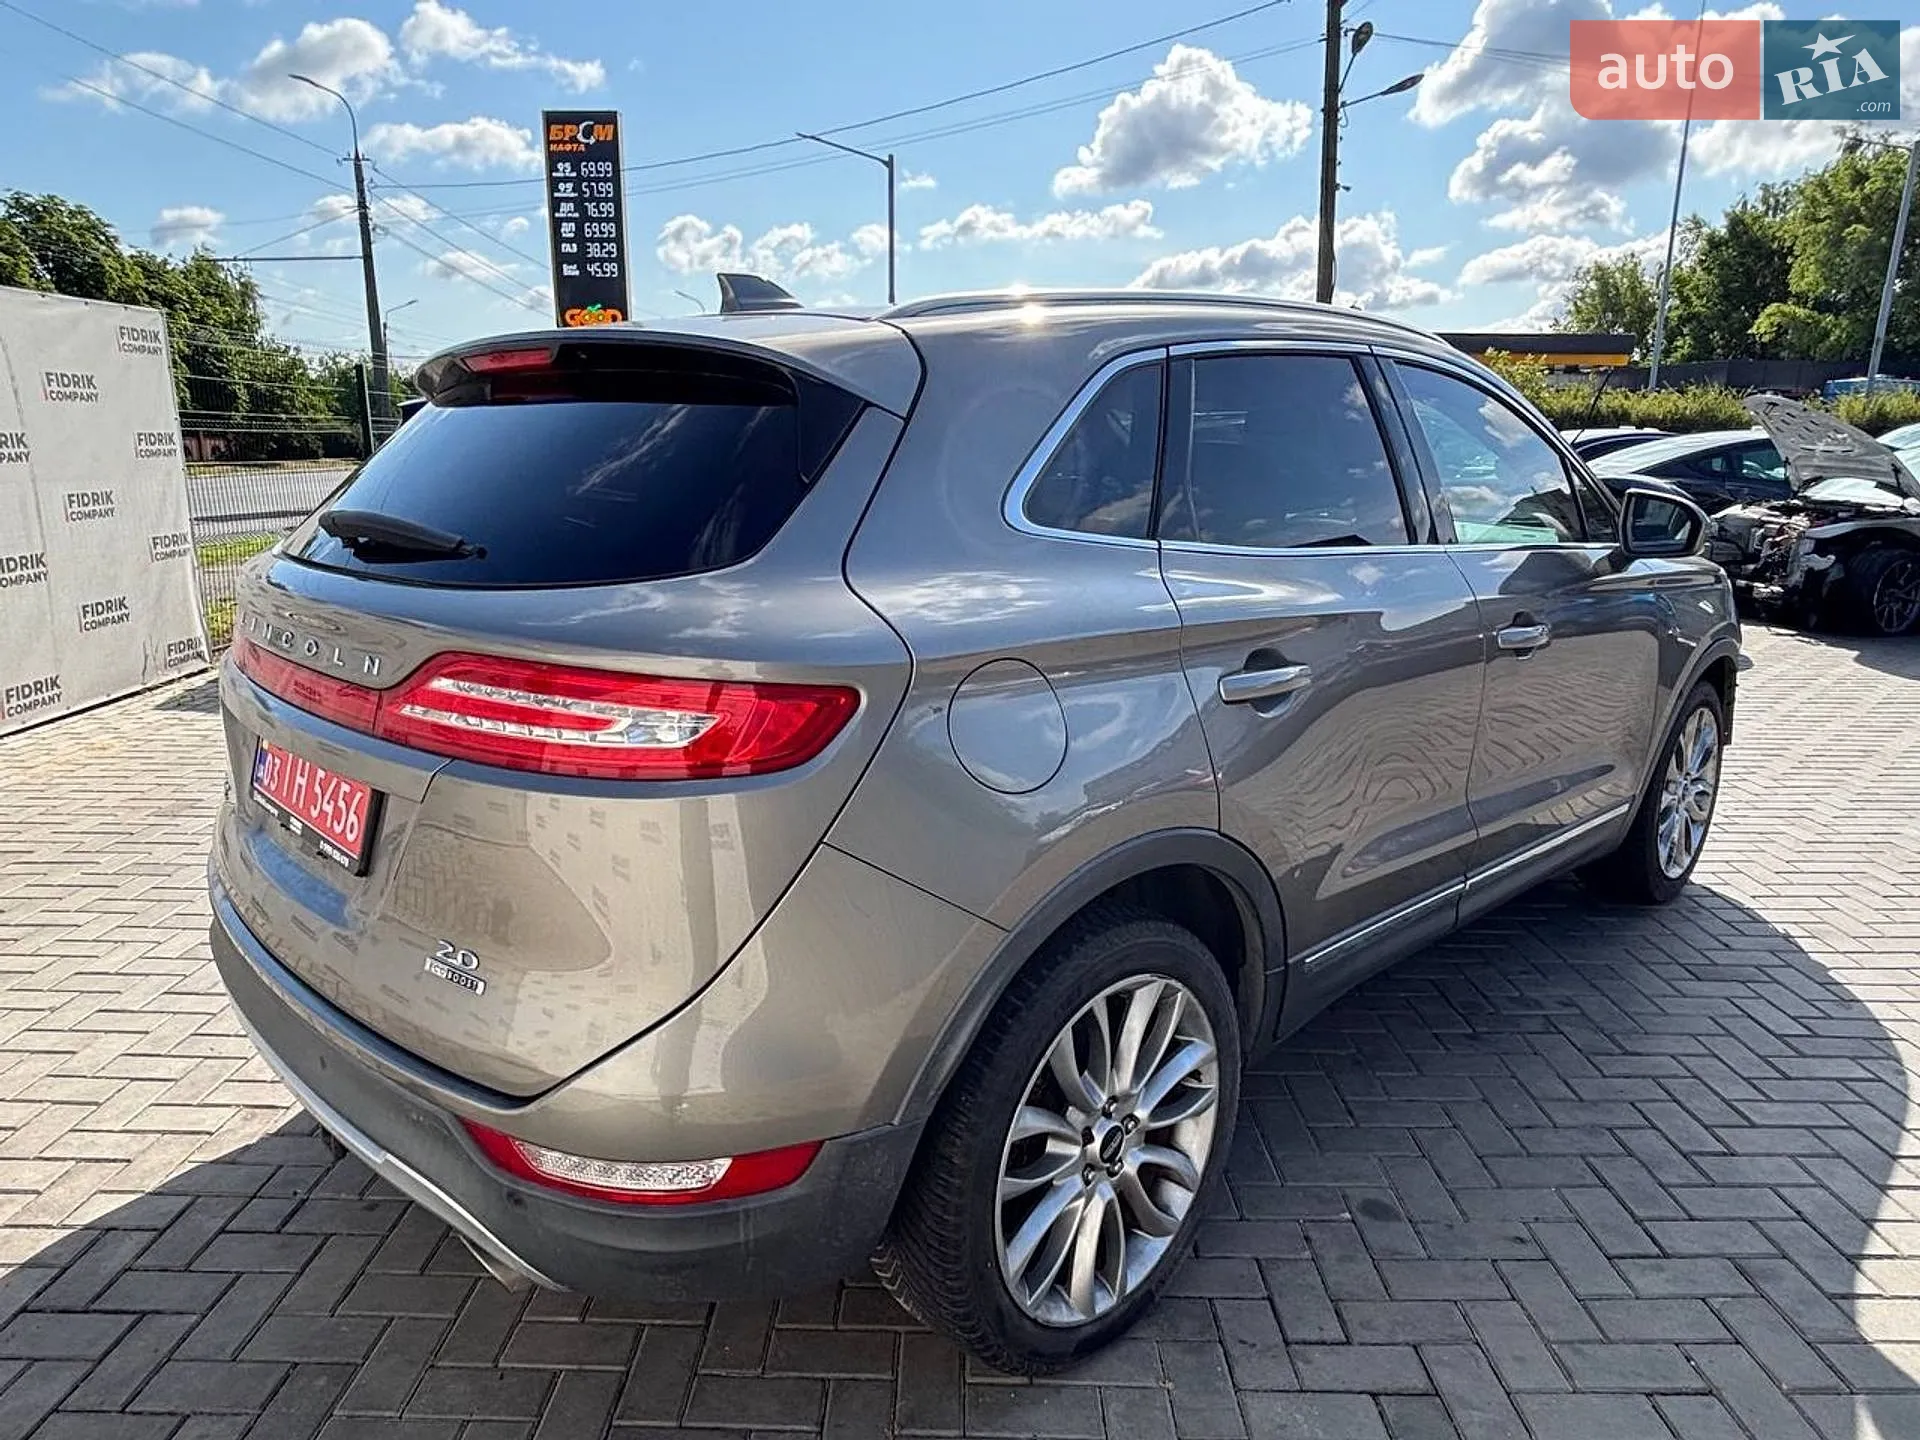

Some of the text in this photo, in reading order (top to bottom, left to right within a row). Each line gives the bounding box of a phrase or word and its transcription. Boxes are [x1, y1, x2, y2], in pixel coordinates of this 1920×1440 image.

[550, 143, 586, 152] НАФТА
[580, 162, 612, 177] 69.99
[582, 182, 613, 197] 57.99
[583, 202, 615, 217] 76.99
[584, 222, 616, 238] 69.99
[586, 243, 617, 258] 38.29
[587, 263, 618, 277] 45.99
[119, 325, 162, 344] FIDRIK
[121, 342, 163, 355] COMPANY
[44, 371, 97, 390] FIDRIK
[48, 390, 99, 403] COMPANY
[136, 431, 176, 447] FIDRIK
[139, 448, 177, 459] COMPANY
[67, 491, 115, 508] FIDRIK
[69, 507, 116, 522] COMPANY
[152, 532, 189, 550] FIDRIK
[82, 596, 129, 620] FIDRIK
[83, 612, 130, 632] COMPANY
[241, 611, 381, 676] LINCOLN
[5, 674, 62, 704] FIDRIK
[7, 692, 62, 718] COMPANY
[263, 752, 281, 792] 03
[310, 768, 363, 843] 5456
